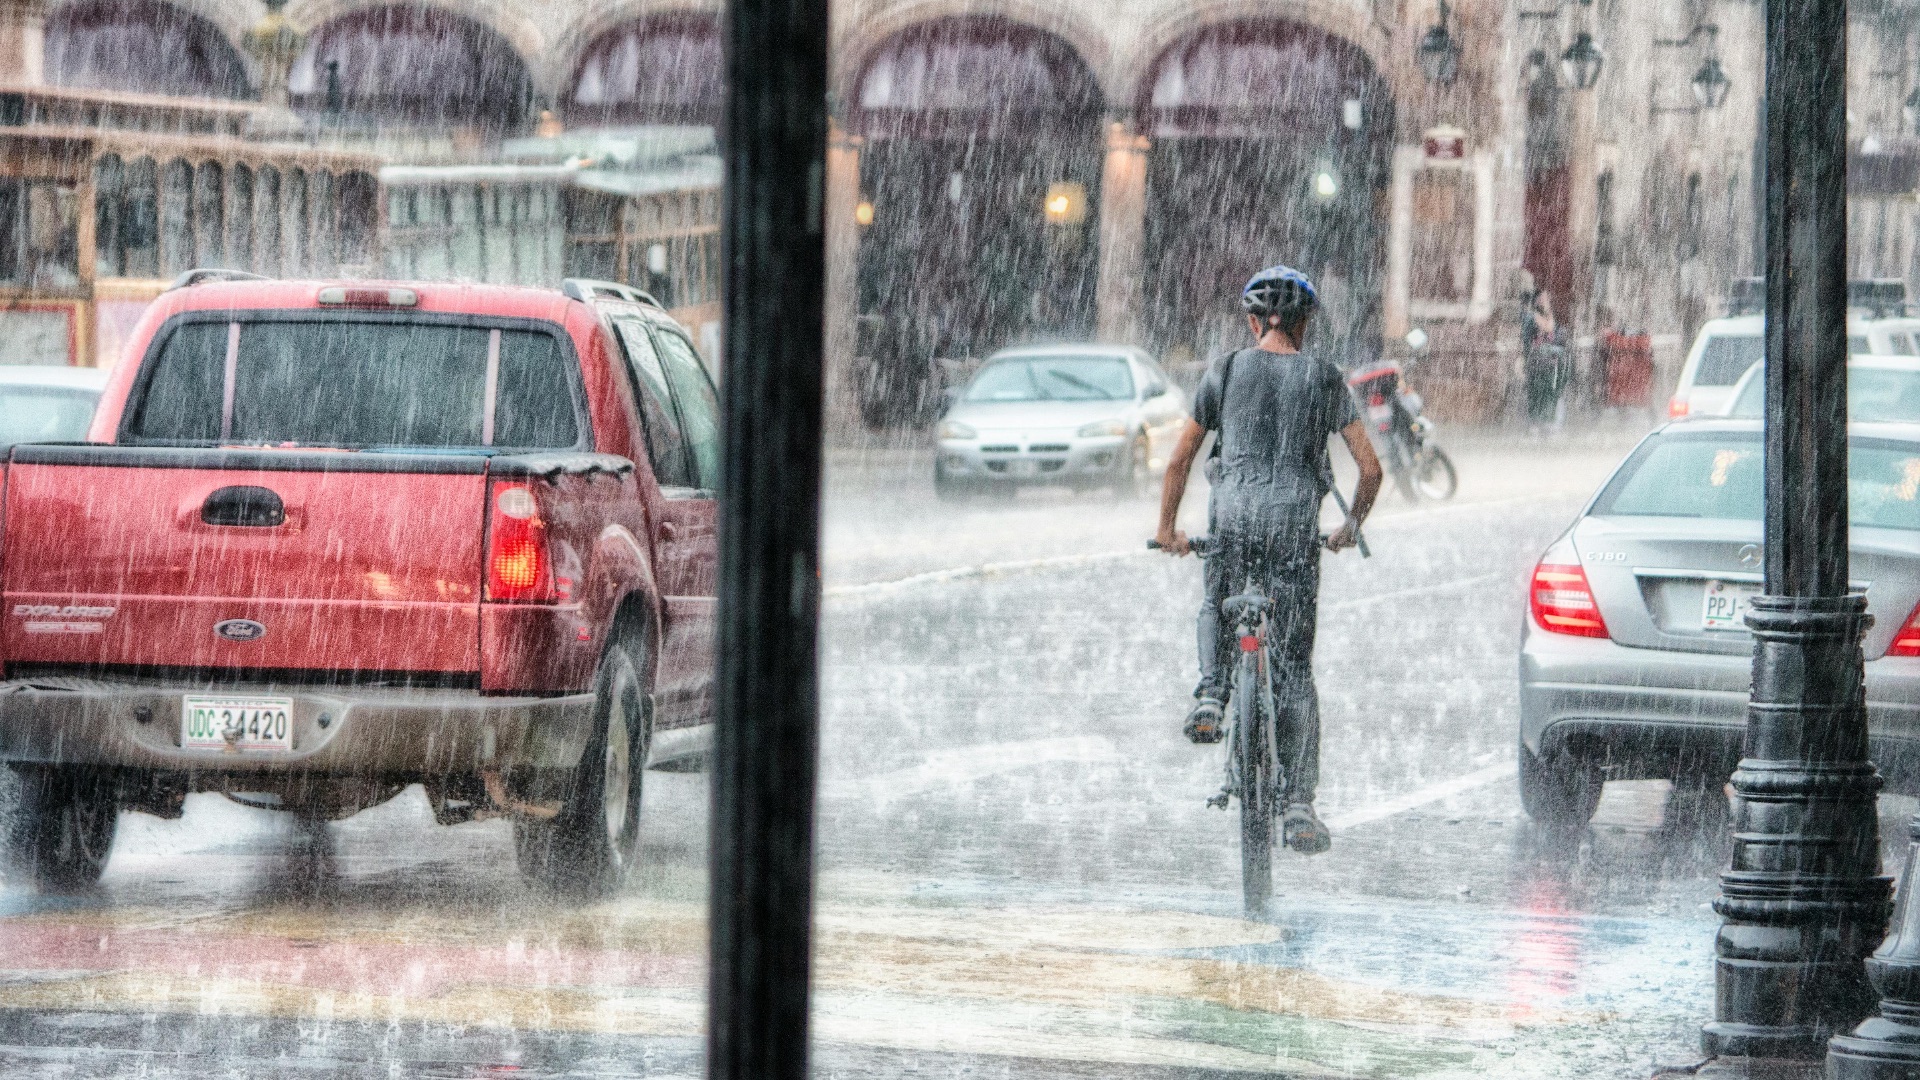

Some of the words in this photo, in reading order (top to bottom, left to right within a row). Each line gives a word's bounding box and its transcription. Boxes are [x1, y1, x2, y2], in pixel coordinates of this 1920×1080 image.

[13, 604, 116, 617] EXPLORER
[1707, 596, 1744, 616] PPJ-
[188, 709, 287, 740] UDC-34420
